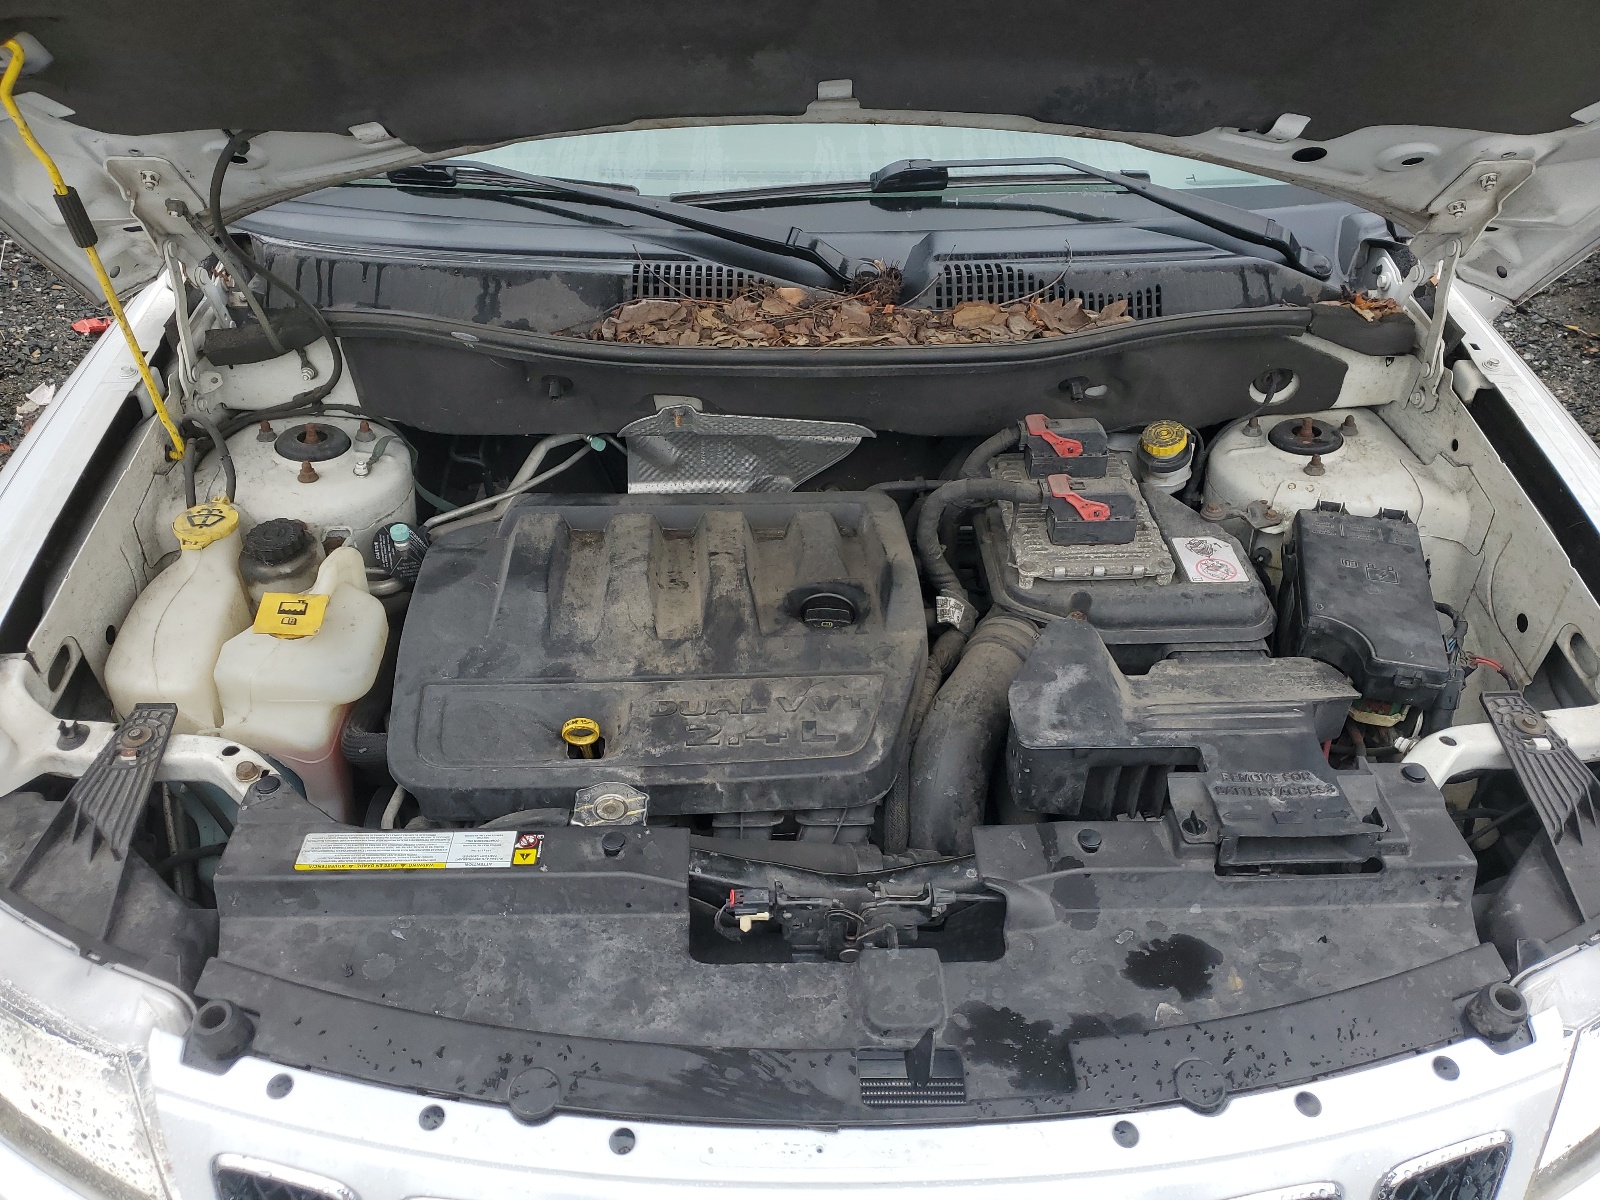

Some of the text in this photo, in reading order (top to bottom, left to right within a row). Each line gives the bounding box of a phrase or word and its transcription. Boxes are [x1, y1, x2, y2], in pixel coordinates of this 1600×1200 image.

[649, 693, 869, 718] DUAL VVT
[684, 719, 838, 747] 2.4L
[1221, 770, 1312, 783] REMOVE FOR
[1213, 783, 1337, 798] BATTERY ACCESS
